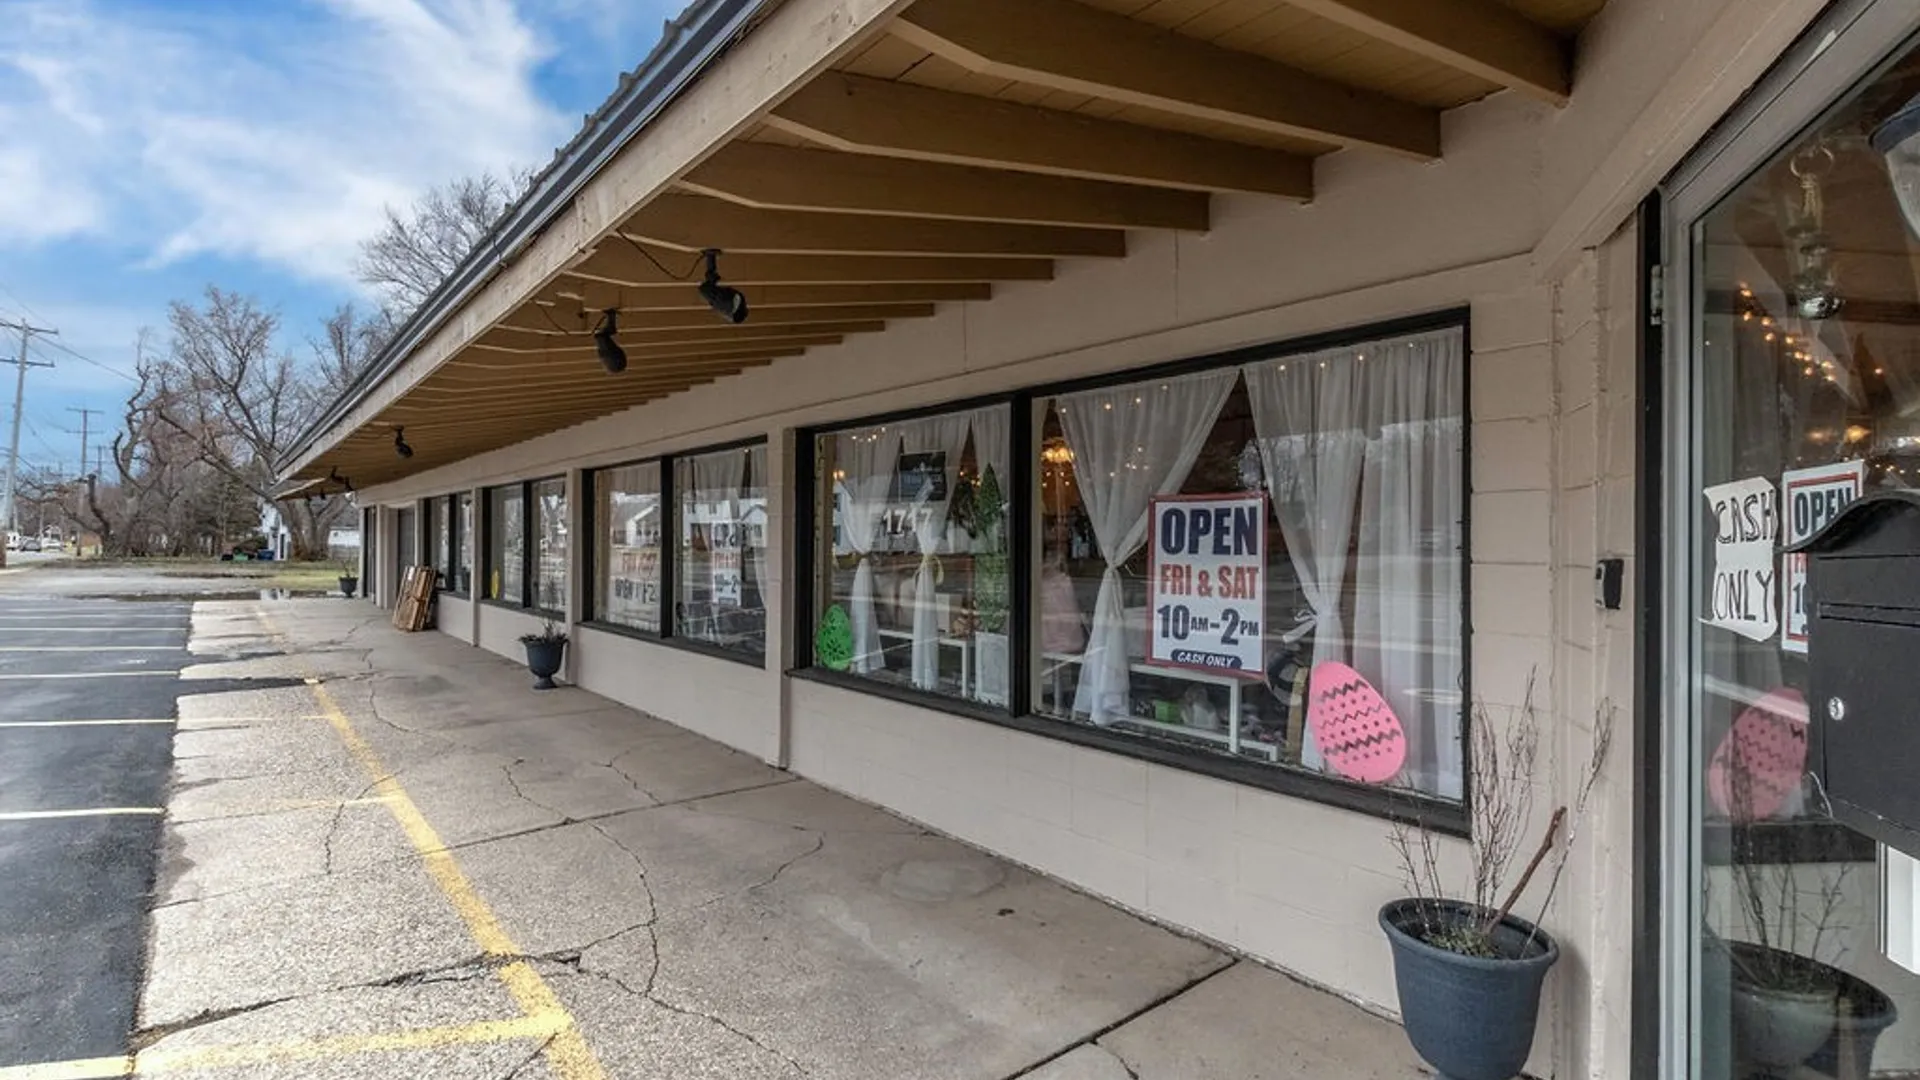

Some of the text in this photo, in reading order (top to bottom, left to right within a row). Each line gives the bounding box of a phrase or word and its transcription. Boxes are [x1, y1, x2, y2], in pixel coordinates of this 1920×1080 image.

[883, 507, 933, 533] 1717
[1161, 506, 1258, 556] OPEN
[1715, 489, 1775, 544] CASH
[1160, 564, 1259, 600] FRI & SAT
[1713, 569, 1773, 623] ONLY
[1177, 651, 1235, 668] CASH ONLY
